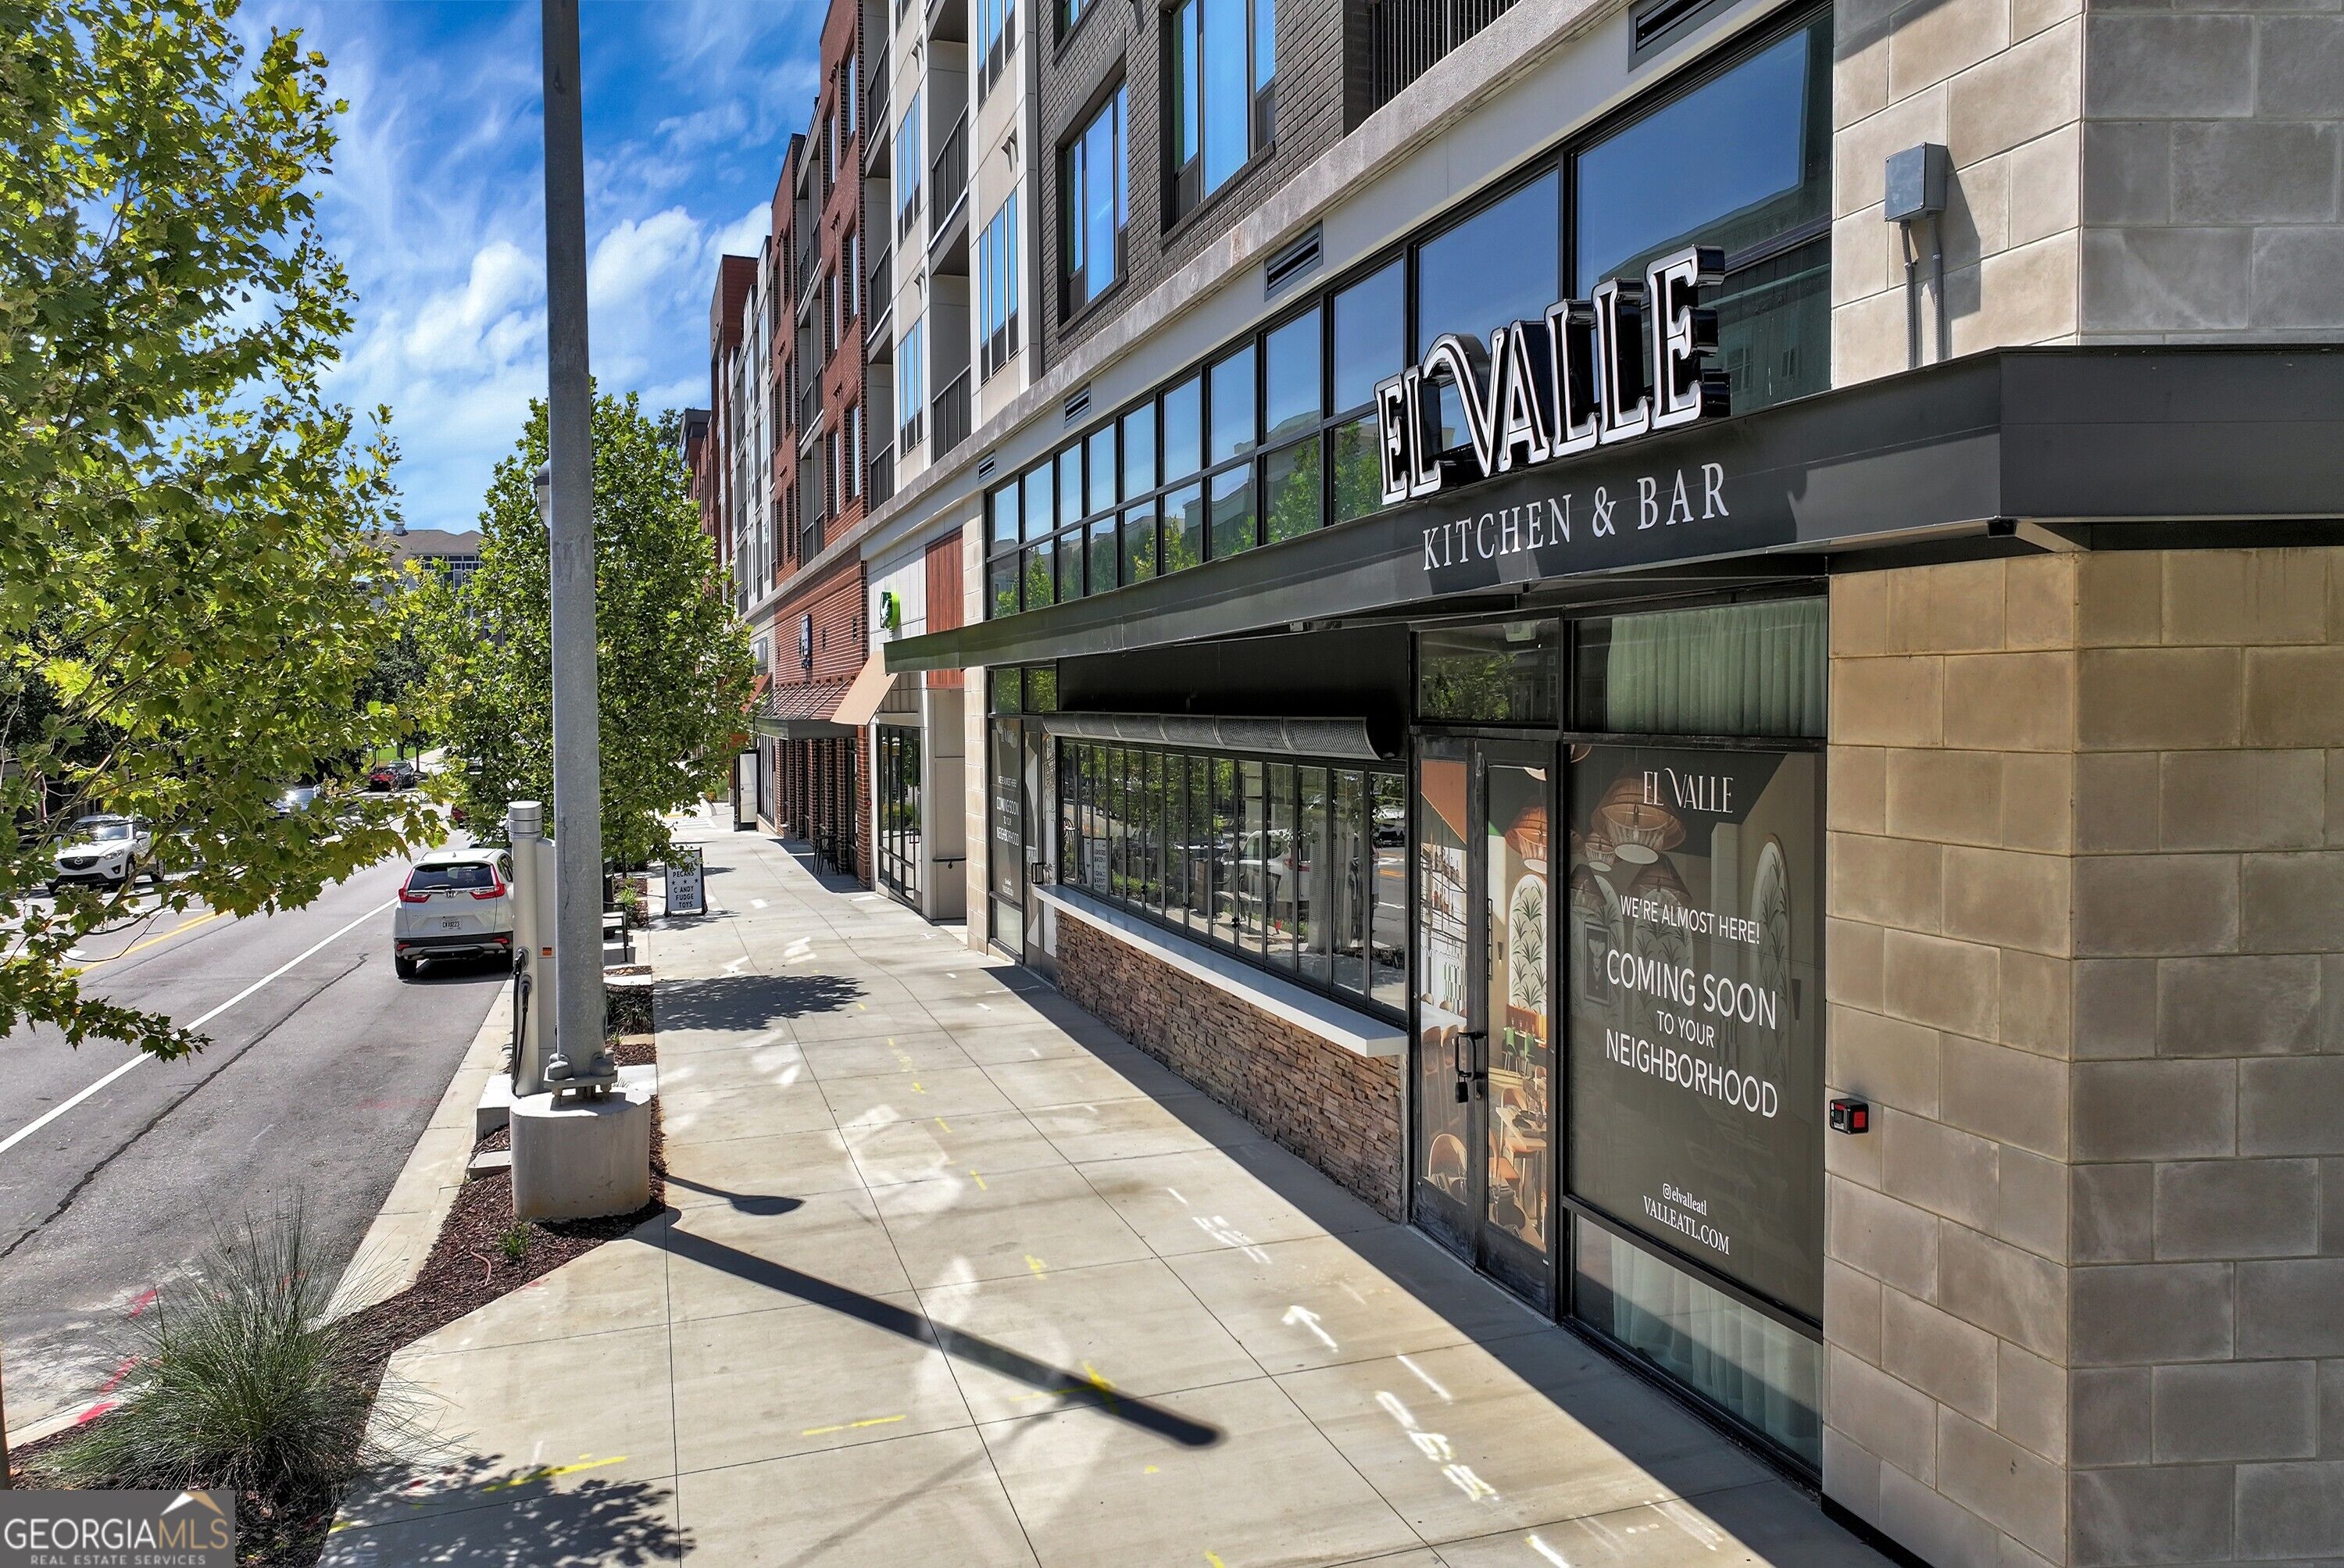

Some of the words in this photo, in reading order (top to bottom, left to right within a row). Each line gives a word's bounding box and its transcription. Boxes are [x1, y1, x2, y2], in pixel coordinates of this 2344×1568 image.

[1374, 365, 1440, 505] EL
[1422, 245, 1711, 478] VALLE
[1422, 493, 1572, 572] KITCHEN
[1592, 485, 1617, 538] &
[1636, 462, 1730, 530] BAR
[1643, 770, 1664, 805] EL
[1663, 767, 1733, 813] VALLE
[1620, 895, 1658, 923] WE'RE
[1661, 904, 1715, 934] ALMOST
[1719, 915, 1760, 945] HERE!
[1606, 949, 1695, 1006] COMING
[1703, 973, 1776, 1030] SOON
[1656, 1010, 1674, 1035] TO
[1678, 1016, 1715, 1048] YOUR
[1606, 1028, 1778, 1118] NEIGHBORHOOD
[1643, 1195, 1730, 1255] VALLEATL.COM
[1672, 1187, 1707, 1216] elvalleatl
